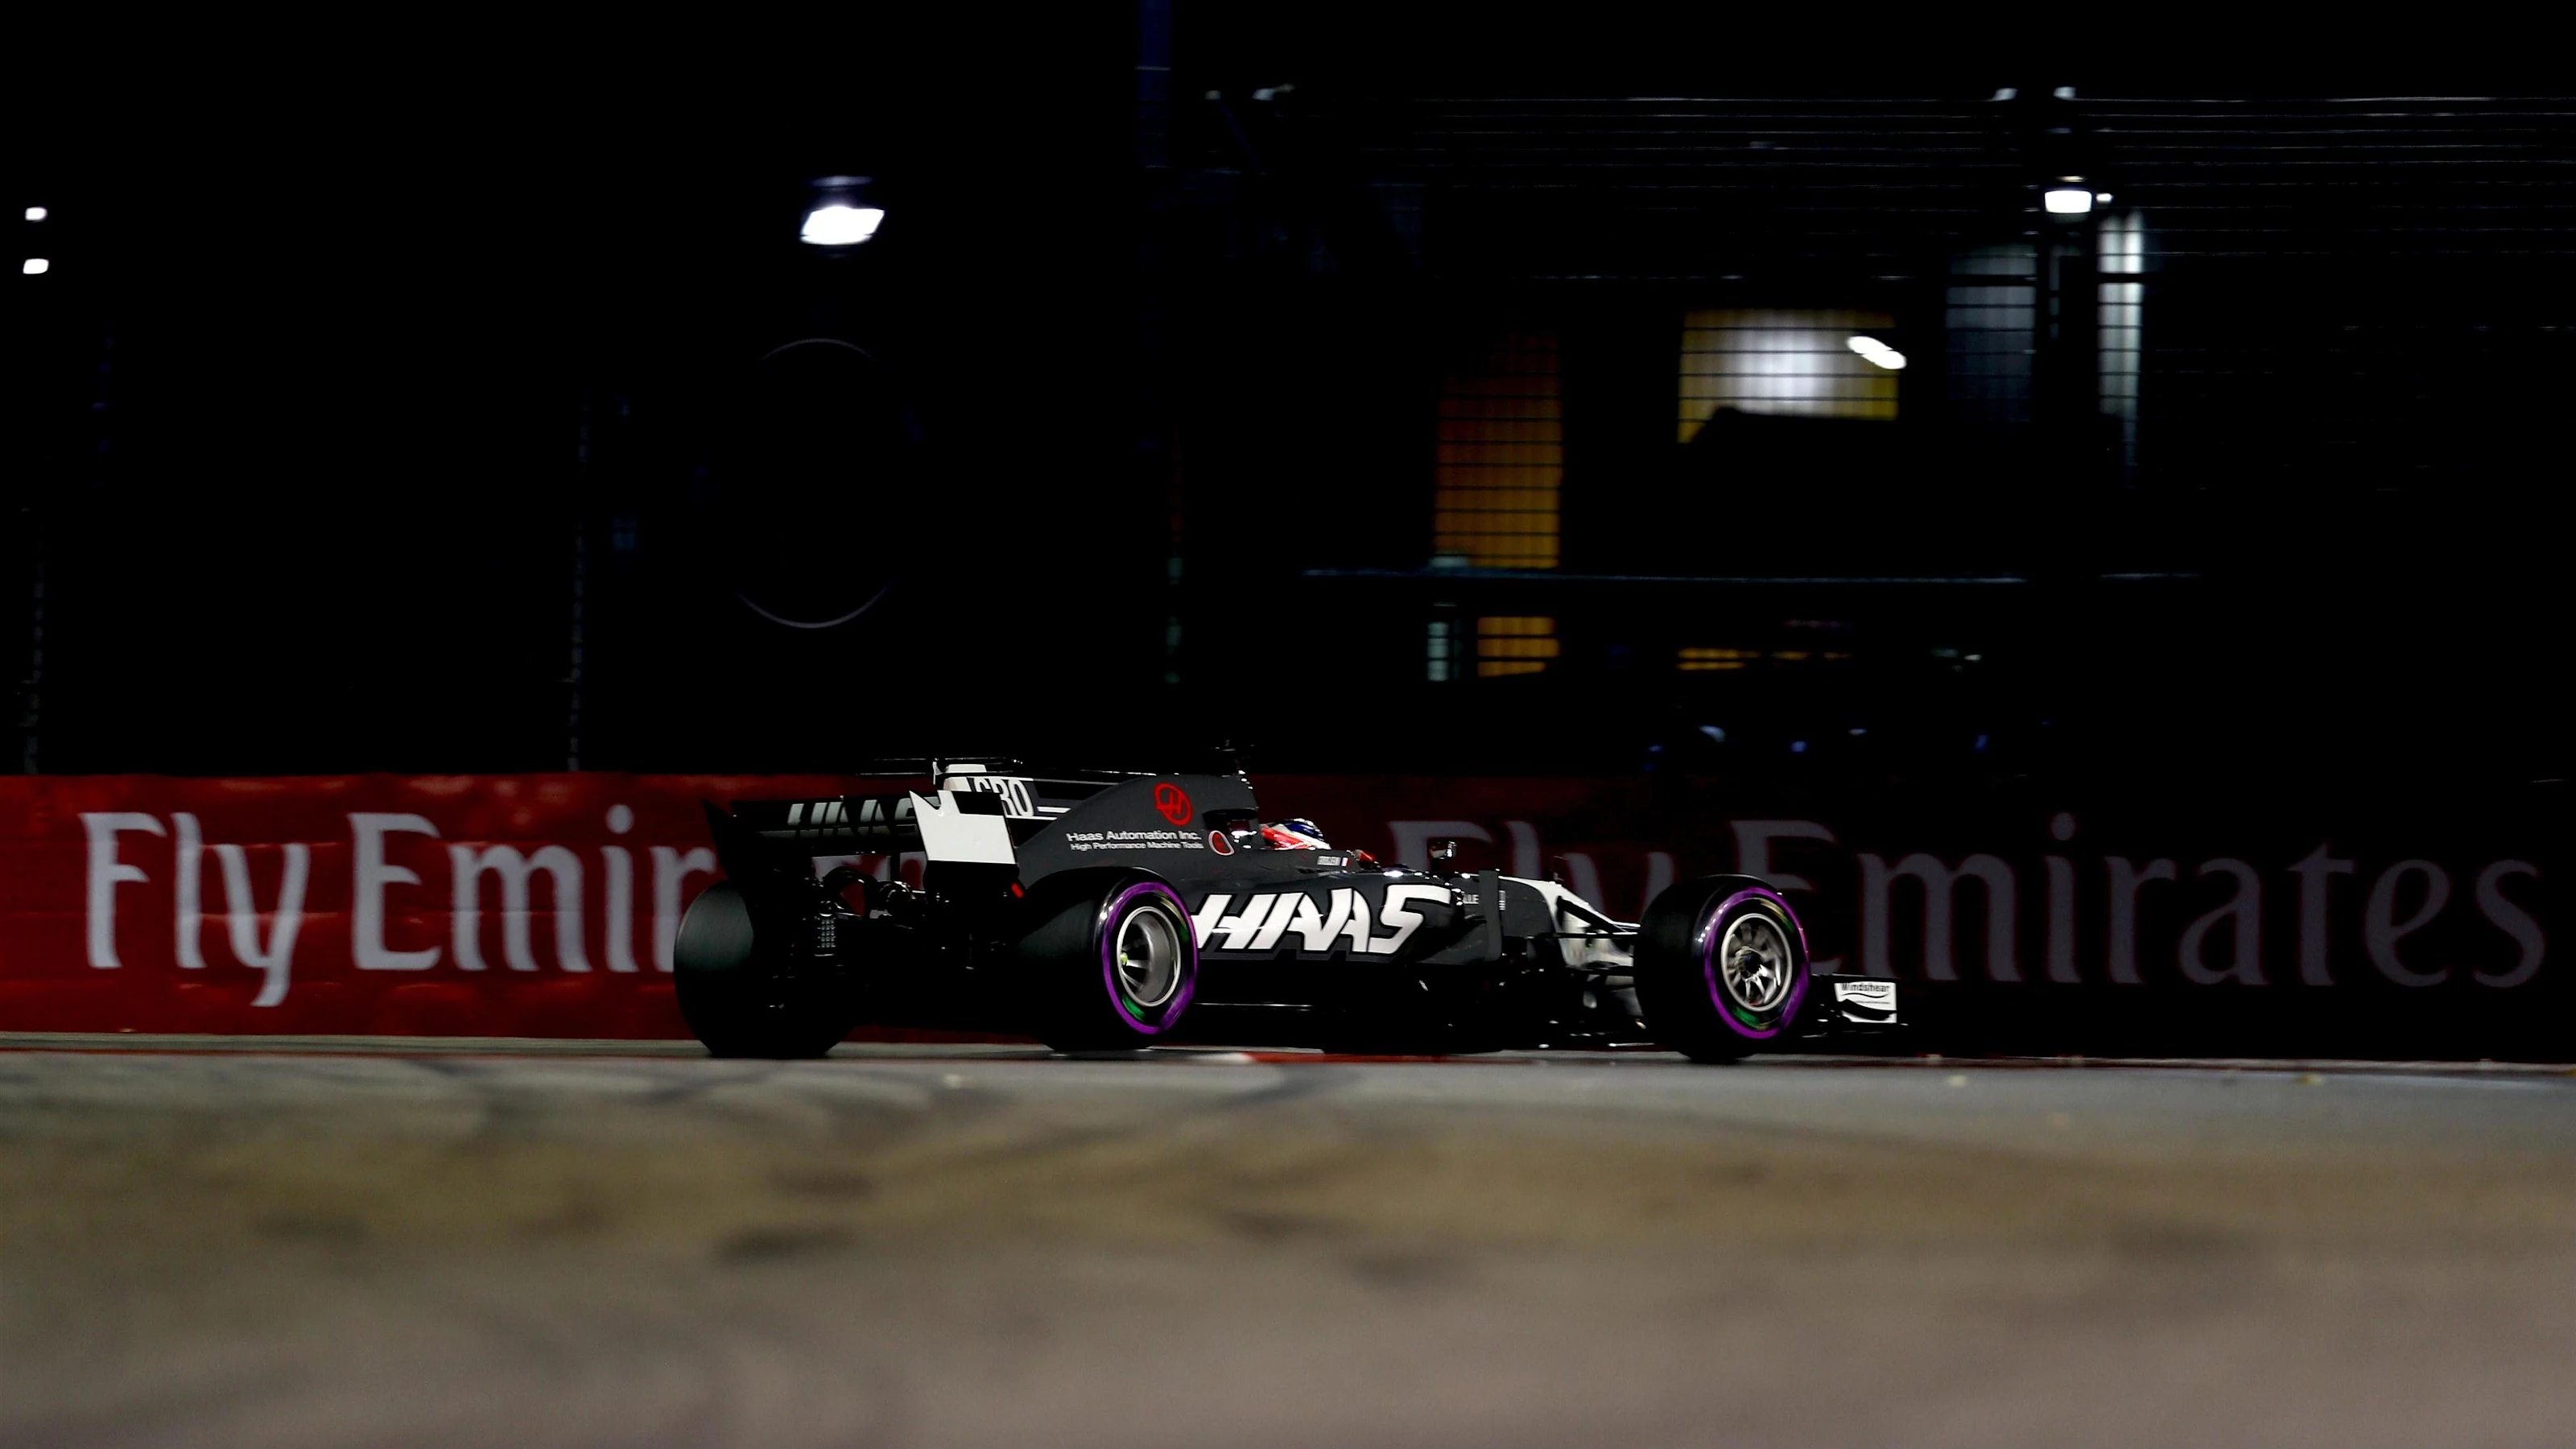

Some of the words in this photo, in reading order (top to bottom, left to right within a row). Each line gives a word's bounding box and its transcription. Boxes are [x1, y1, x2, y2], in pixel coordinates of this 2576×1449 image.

[1066, 832, 1104, 841] Haas
[1106, 830, 1177, 840] Automation
[1179, 830, 1202, 840] Inc.
[1071, 843, 1092, 851] High
[79, 811, 312, 1008] Fly
[346, 803, 927, 973] Emir
[1191, 884, 1451, 955] HAAS
[1729, 809, 2550, 989] Emirates
